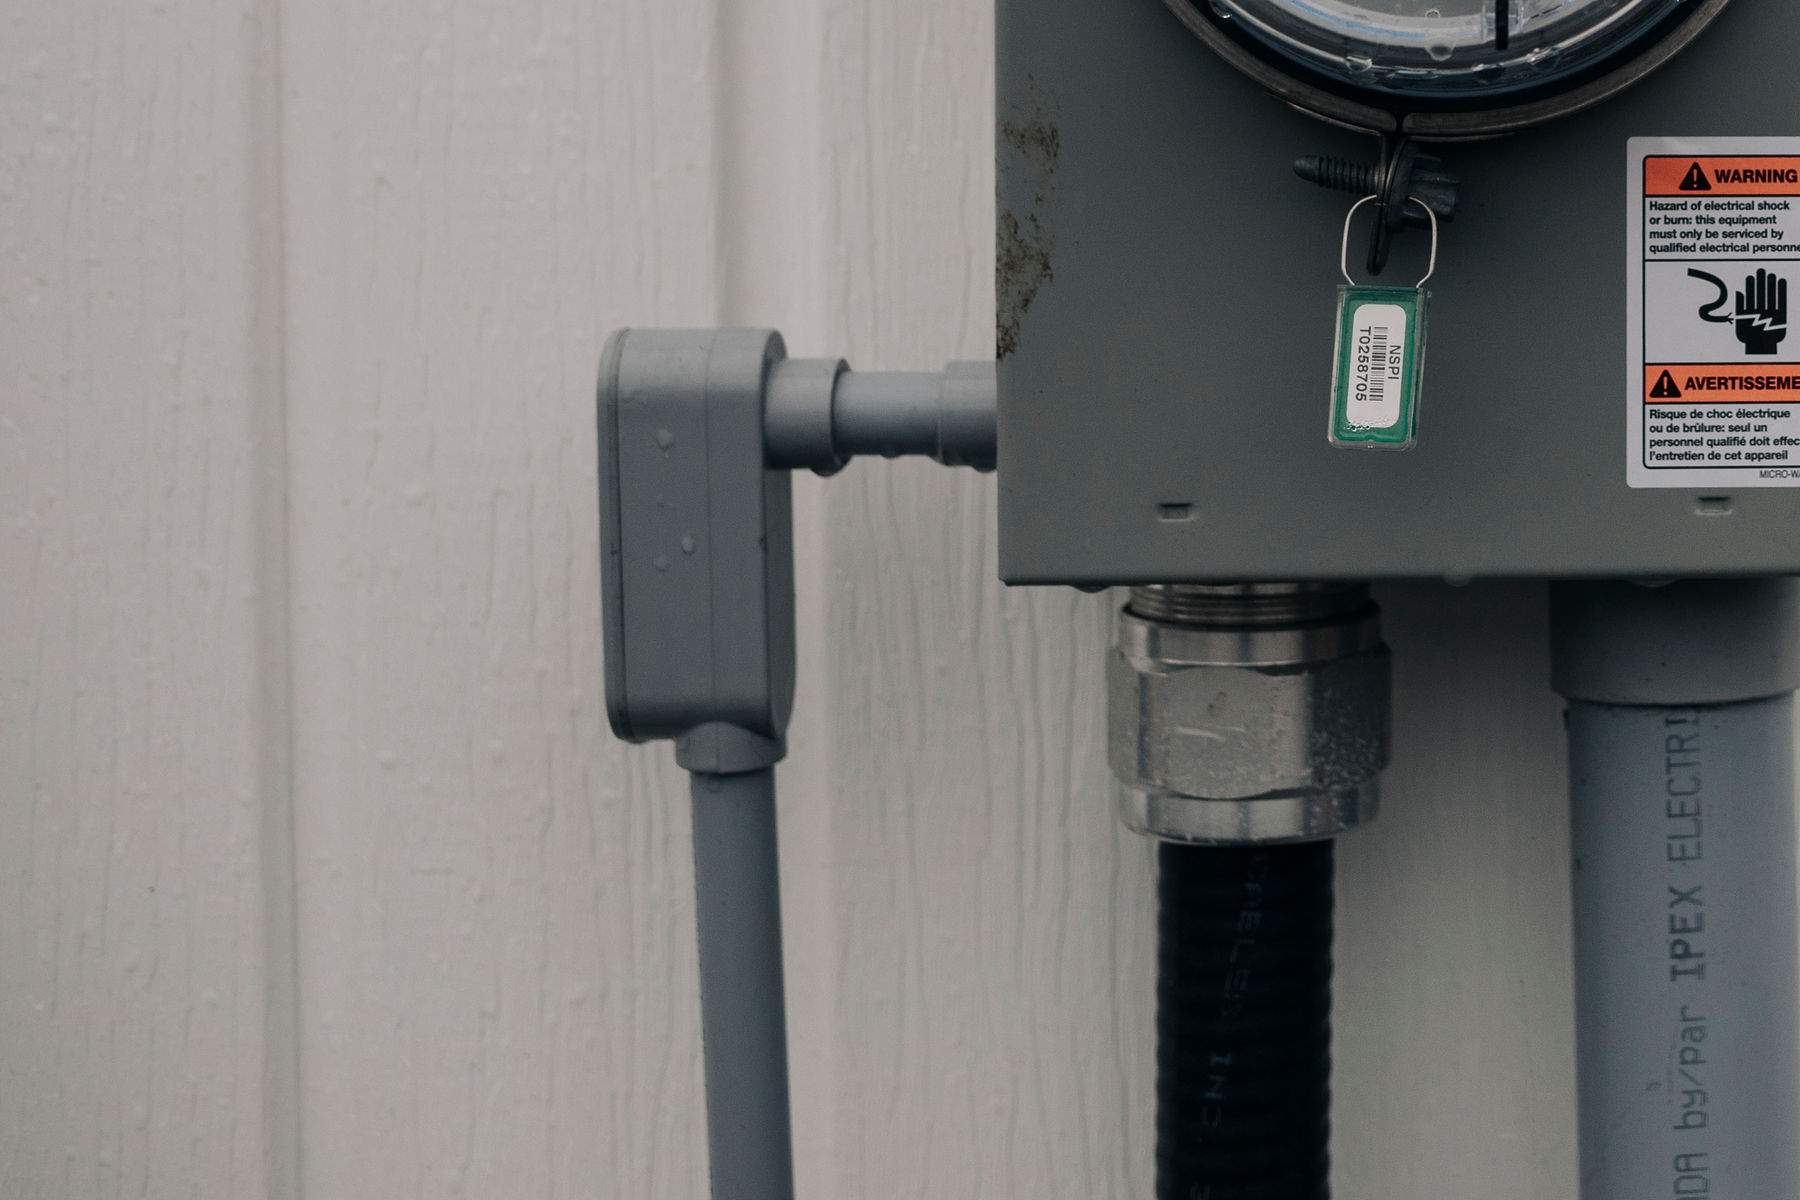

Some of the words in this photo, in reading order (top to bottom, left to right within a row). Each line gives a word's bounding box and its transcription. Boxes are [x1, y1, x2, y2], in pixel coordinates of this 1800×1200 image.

[1713, 169, 1799, 184] WARNING
[1648, 200, 1688, 212] Hazard
[1689, 200, 1703, 211] of
[1703, 200, 1755, 212] electrical
[1757, 200, 1791, 211] shock
[1648, 216, 1662, 226] or
[1663, 214, 1693, 226] burn:
[1694, 214, 1716, 225] this
[1717, 214, 1777, 227] equipment
[1648, 228, 1678, 240] must
[1679, 228, 1703, 241] only
[1704, 228, 1720, 239] be
[1721, 228, 1768, 239] serviced
[1770, 228, 1785, 241] by
[1648, 242, 1697, 255] qualified
[1698, 242, 1750, 253] electrical
[1355, 326, 1371, 402] T0258705
[1387, 344, 1401, 380] NSPI
[1649, 408, 1688, 422] Risque
[1689, 408, 1704, 419] de
[1705, 408, 1734, 419] choc
[1735, 408, 1791, 421] électrique
[1648, 424, 1664, 434] ou
[1665, 422, 1681, 434] de
[1682, 422, 1726, 433] brûlure:
[1727, 422, 1751, 433] seul
[1753, 424, 1768, 433] un
[1649, 436, 1704, 450] personnel
[1705, 435, 1747, 449] qualifié
[1748, 435, 1771, 447] doit
[1649, 450, 1705, 461] l'entretien
[1707, 450, 1722, 461] de
[1723, 450, 1742, 461] cet
[1744, 449, 1789, 463] appareil
[1668, 884, 1706, 983] IPEX
[1672, 1004, 1708, 1130] by/par
